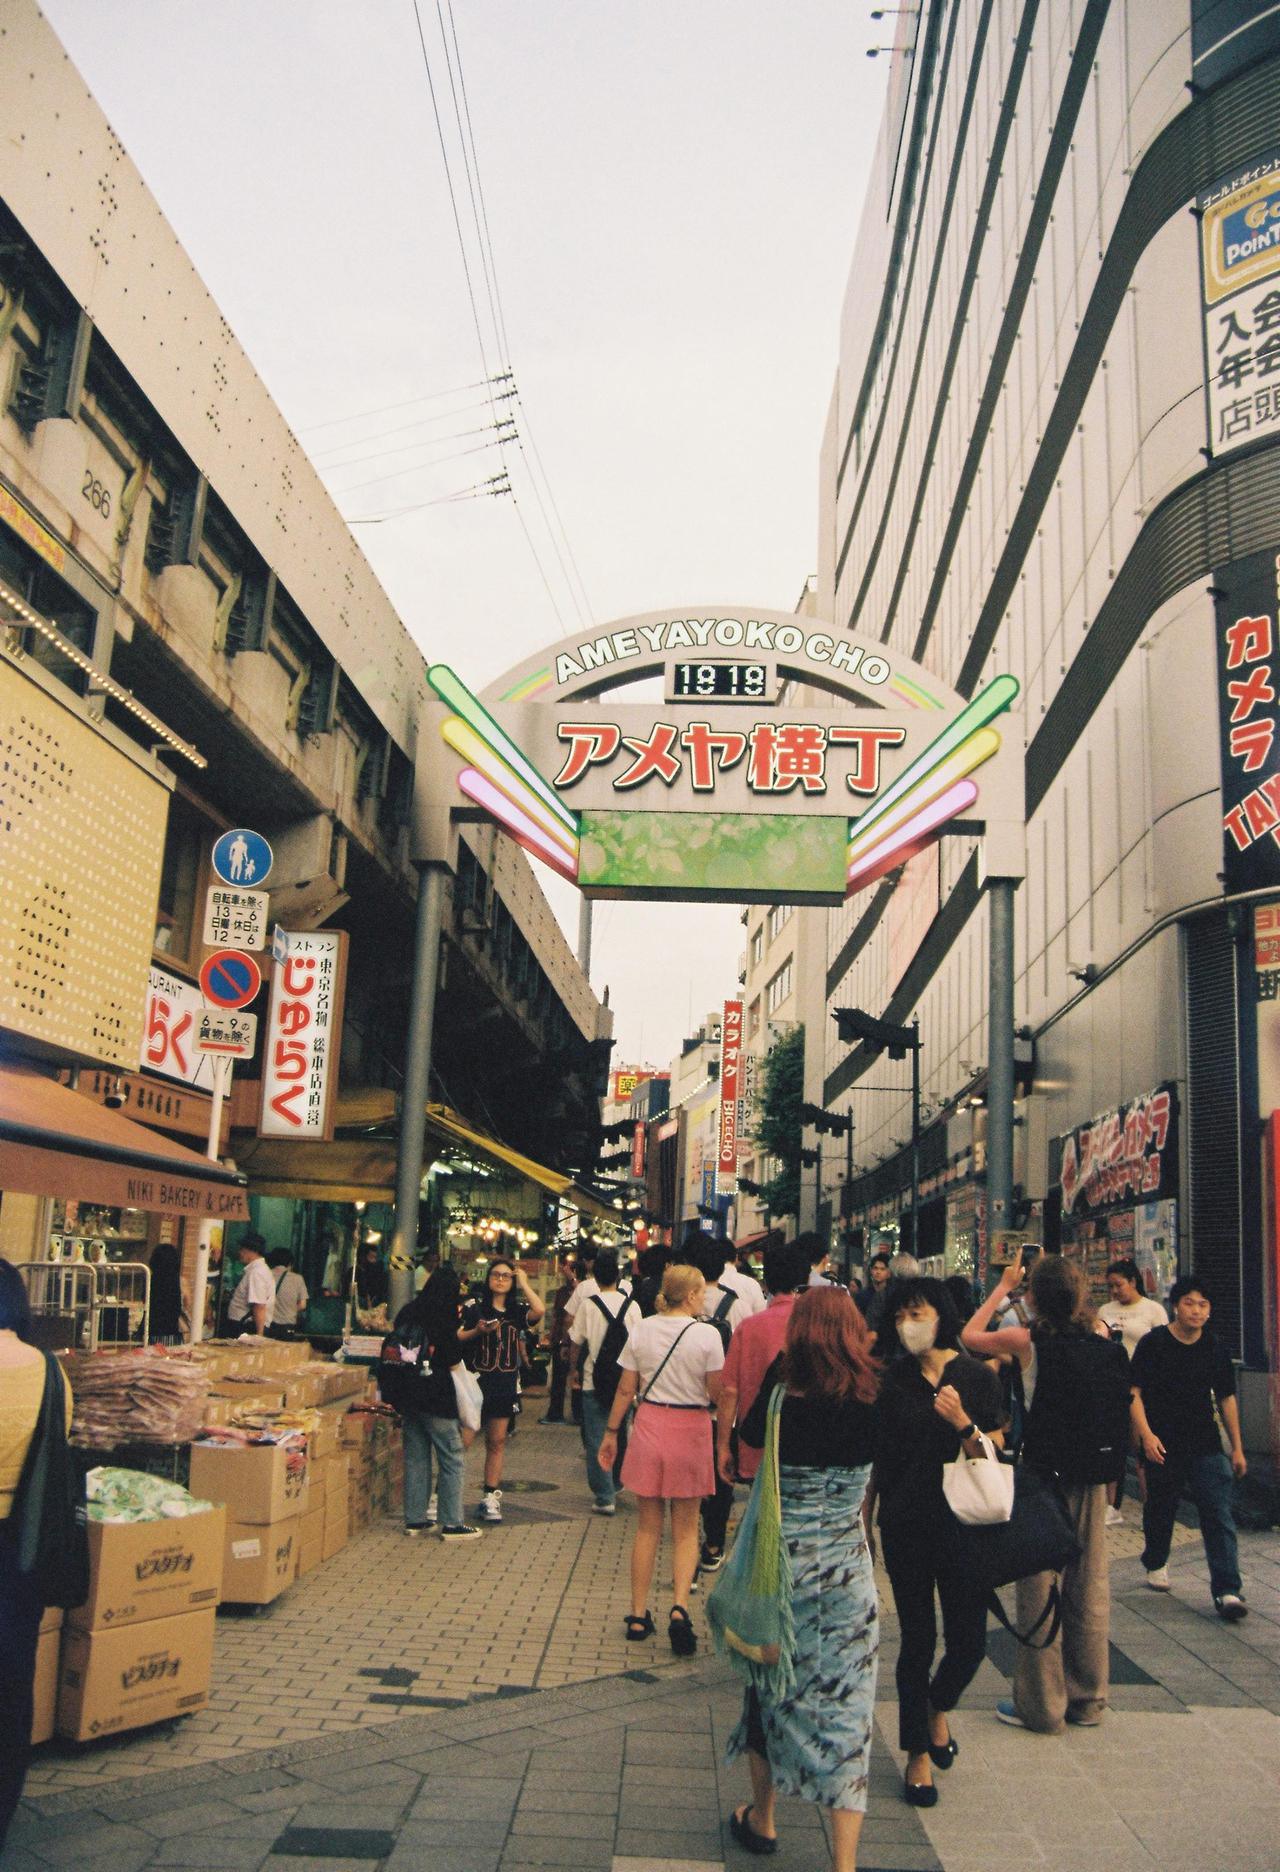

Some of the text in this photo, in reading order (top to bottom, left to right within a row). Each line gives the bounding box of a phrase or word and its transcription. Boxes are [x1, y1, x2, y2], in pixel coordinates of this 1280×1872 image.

[1216, 289, 1280, 354] 入会
[1217, 332, 1280, 390] 年会
[82, 469, 111, 520] 266
[555, 618, 891, 686] AMEYAYOKOCHO
[1226, 614, 1275, 773] カメラ
[552, 721, 907, 795] アメヤ横丁
[212, 892, 263, 908] 自転車を除く
[315, 957, 332, 1028] 東京名物
[147, 994, 192, 1078] らく
[199, 1027, 250, 1044] 貨物を除く
[271, 957, 316, 1127] じゅらく
[724, 1010, 740, 1077] カラオケ
[620, 1078, 636, 1093] 薬
[128, 1179, 153, 1202] NIKI
[160, 1184, 199, 1209] BAKERY
[206, 1192, 213, 1210] &
